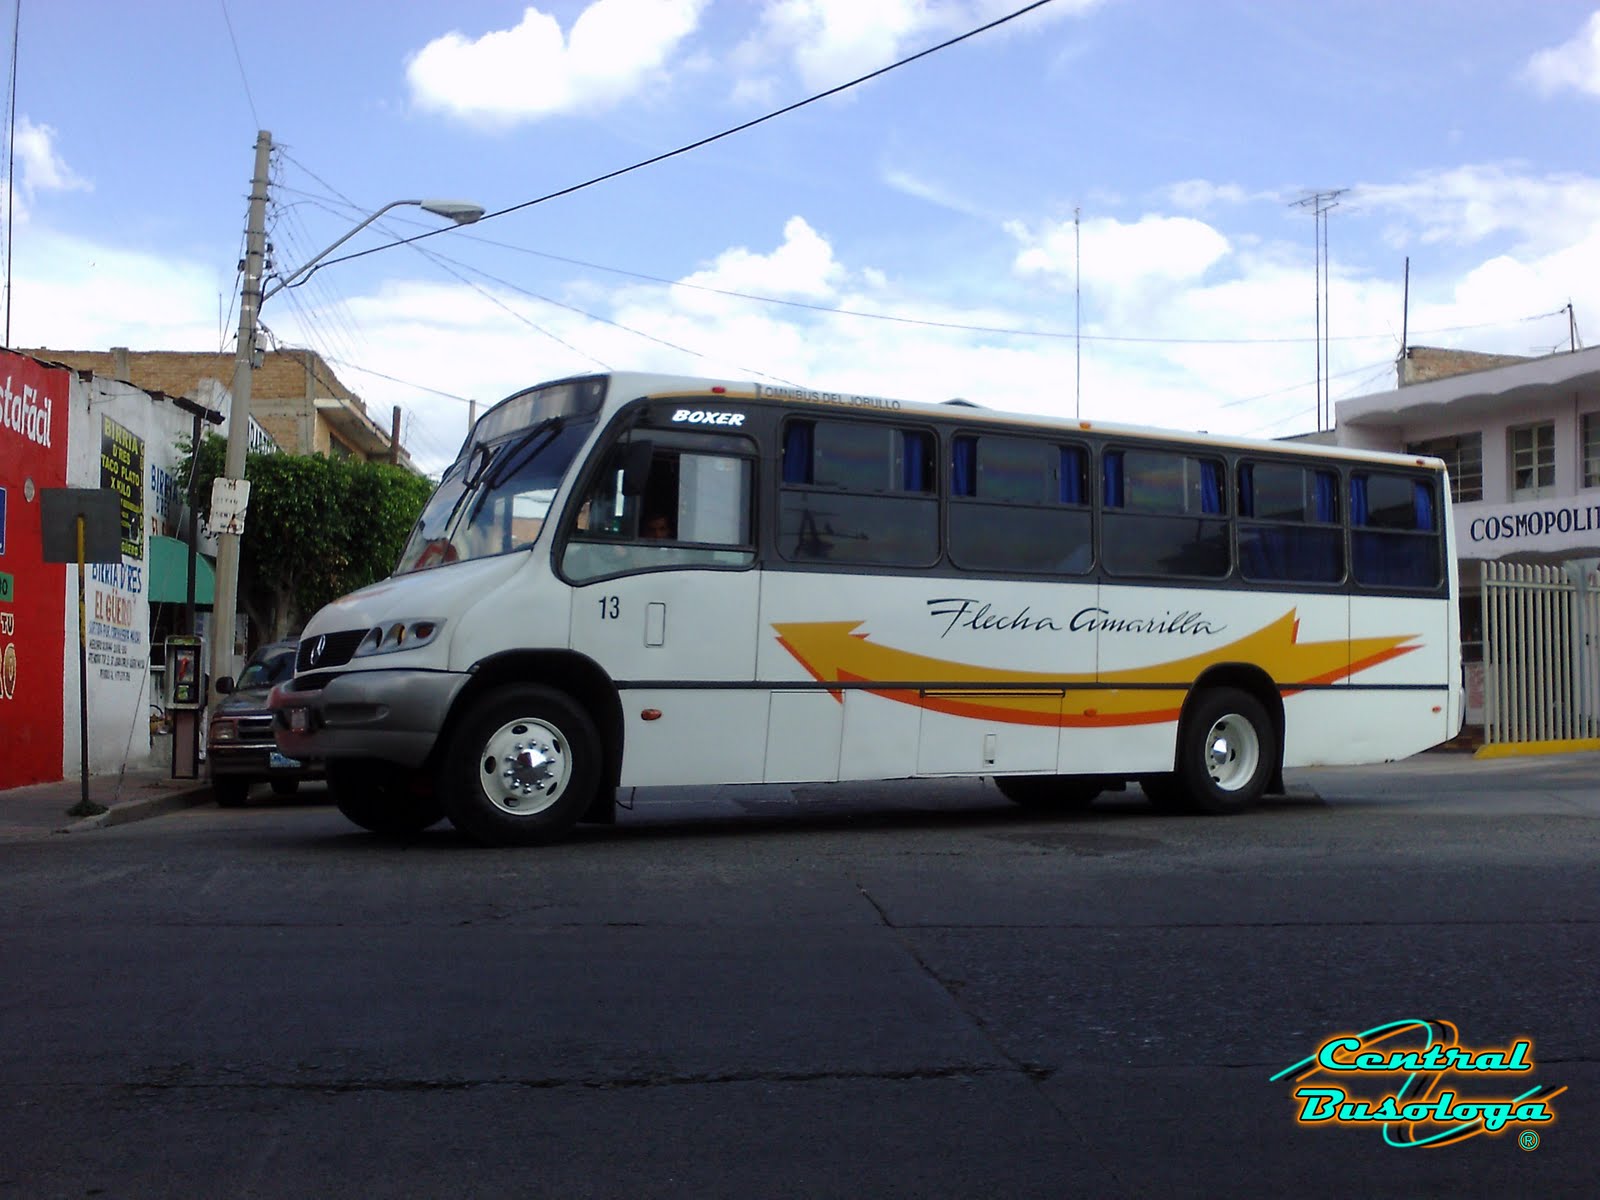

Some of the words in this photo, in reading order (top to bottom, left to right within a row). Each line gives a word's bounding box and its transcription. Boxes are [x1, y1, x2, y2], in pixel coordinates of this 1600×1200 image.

[765, 386, 819, 402] OMNIBUS
[822, 392, 845, 405] DEL
[849, 395, 901, 411] JORULLO
[672, 409, 745, 426] BOXER
[103, 416, 139, 455] BIRRIA
[101, 453, 119, 475] TACO
[121, 466, 140, 487] PLATO
[110, 476, 116, 489] X
[94, 590, 104, 620] EL
[598, 596, 620, 620] 13
[926, 598, 1063, 639] Flecha
[1069, 607, 1227, 636] Amarilla
